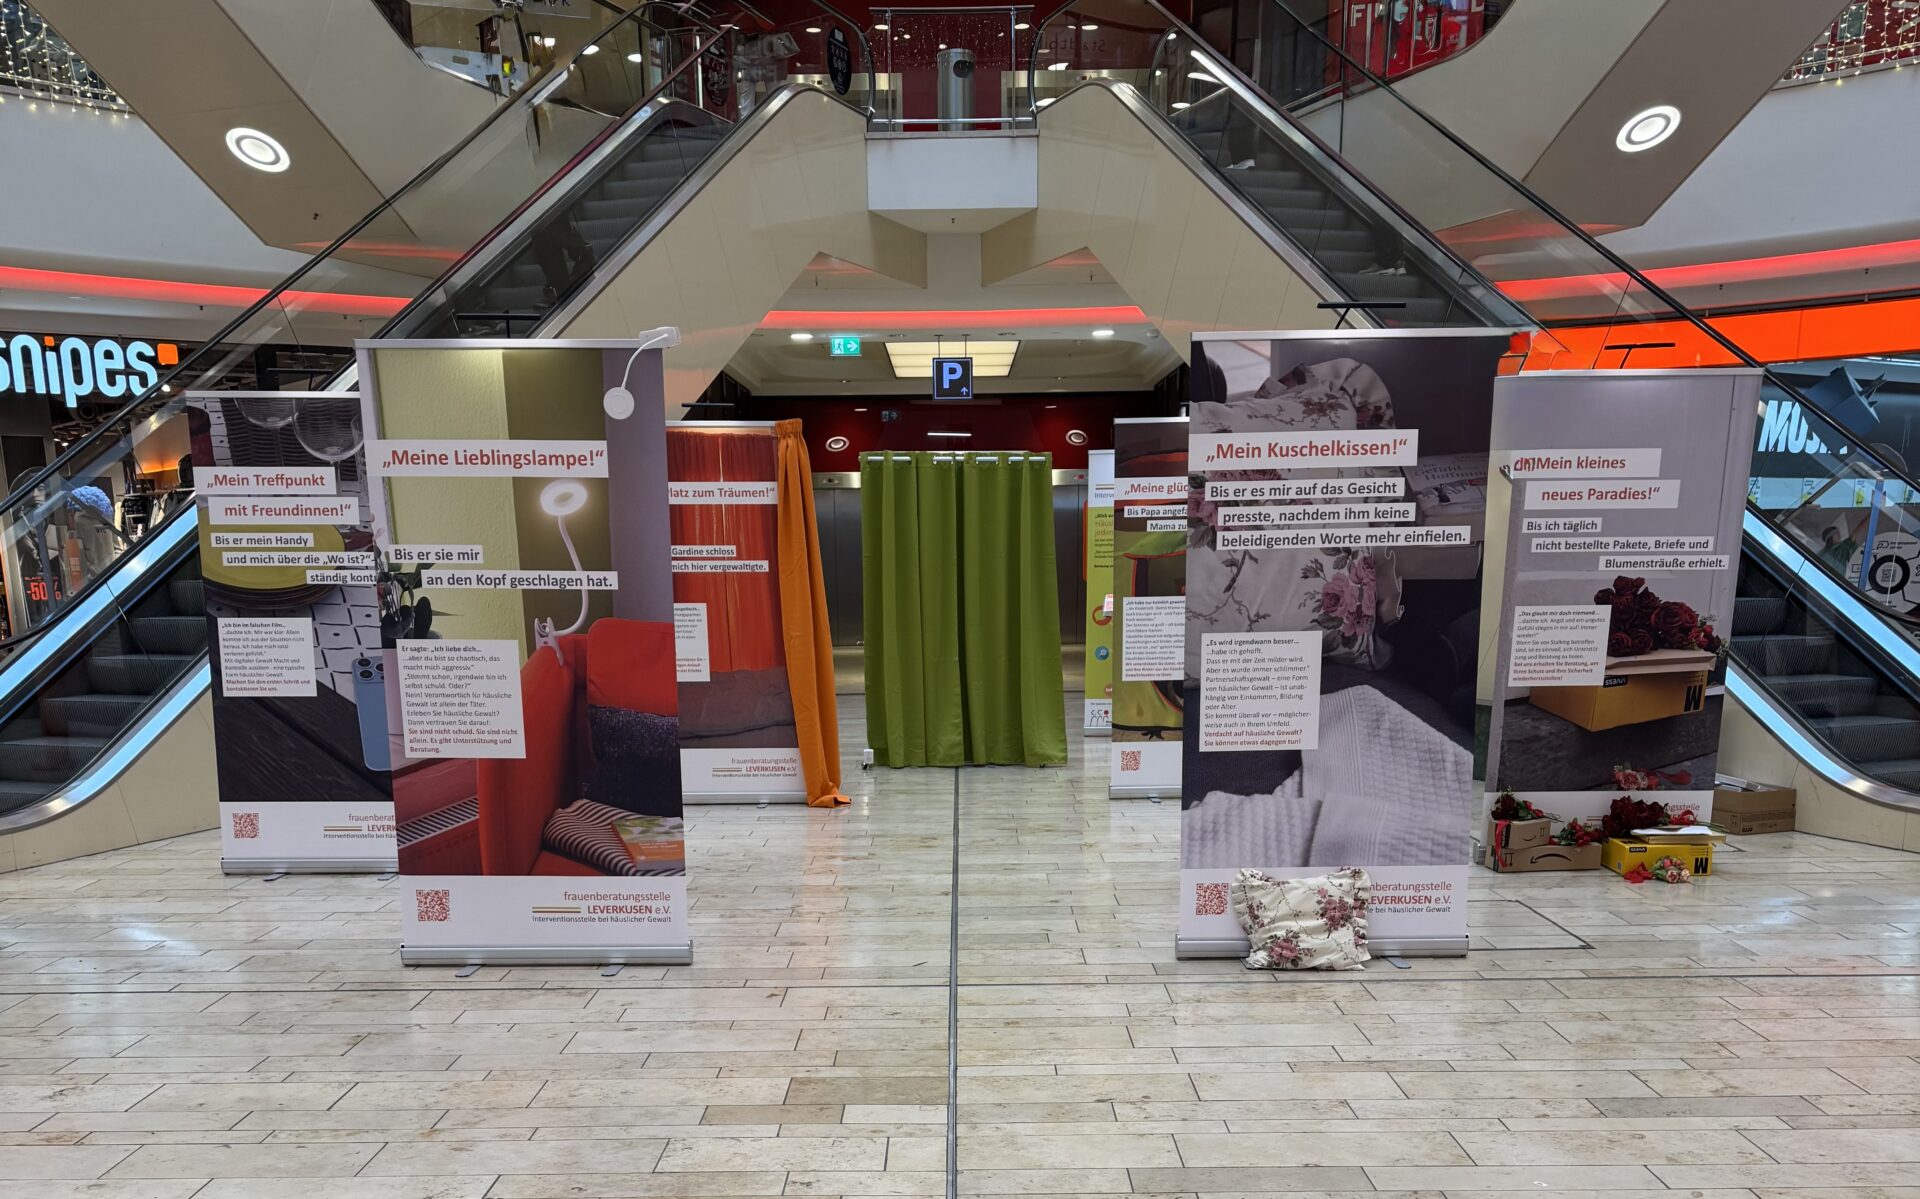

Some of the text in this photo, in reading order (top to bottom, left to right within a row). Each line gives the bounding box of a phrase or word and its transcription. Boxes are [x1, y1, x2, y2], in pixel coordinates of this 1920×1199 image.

[942, 362, 963, 389] P
[1536, 457, 1572, 469] Mein
[1576, 456, 1625, 469] kleines
[252, 473, 325, 488] Treffpunkt
[669, 487, 689, 497] latz
[691, 489, 714, 497] zum
[1210, 482, 1397, 497] Bis er es mir auf das Gesicht
[1541, 490, 1583, 500] neues
[224, 503, 248, 516] mit
[1140, 508, 1160, 516] Papa
[1223, 507, 1409, 524] presste, nachdem ihm keine
[1150, 522, 1175, 530] Mama
[1526, 520, 1597, 532] Bis ich täglich
[214, 535, 308, 547] Bis er mein Handy
[1221, 529, 1466, 547] beleidigenden Worte mehr einfielen.
[1535, 539, 1709, 550] nicht bestellte Pakete, Briefe und
[394, 548, 480, 560] Bis er sie mir
[671, 547, 734, 555] Gardine schloss
[226, 554, 247, 564] und
[249, 554, 274, 564] mich
[277, 554, 301, 564] über
[303, 554, 320, 564] die
[1604, 557, 1725, 568] Blumensträuße erhielt.
[690, 562, 707, 572] hier
[708, 562, 767, 572] vergewaltigte.
[310, 572, 348, 584] ständig
[426, 573, 612, 589] an den Kopf geschlagen hat.
[564, 891, 670, 903] frauenberatungsstelle
[1434, 895, 1451, 904] e.V.
[587, 905, 671, 914] LEVERKUSEN e.V.
